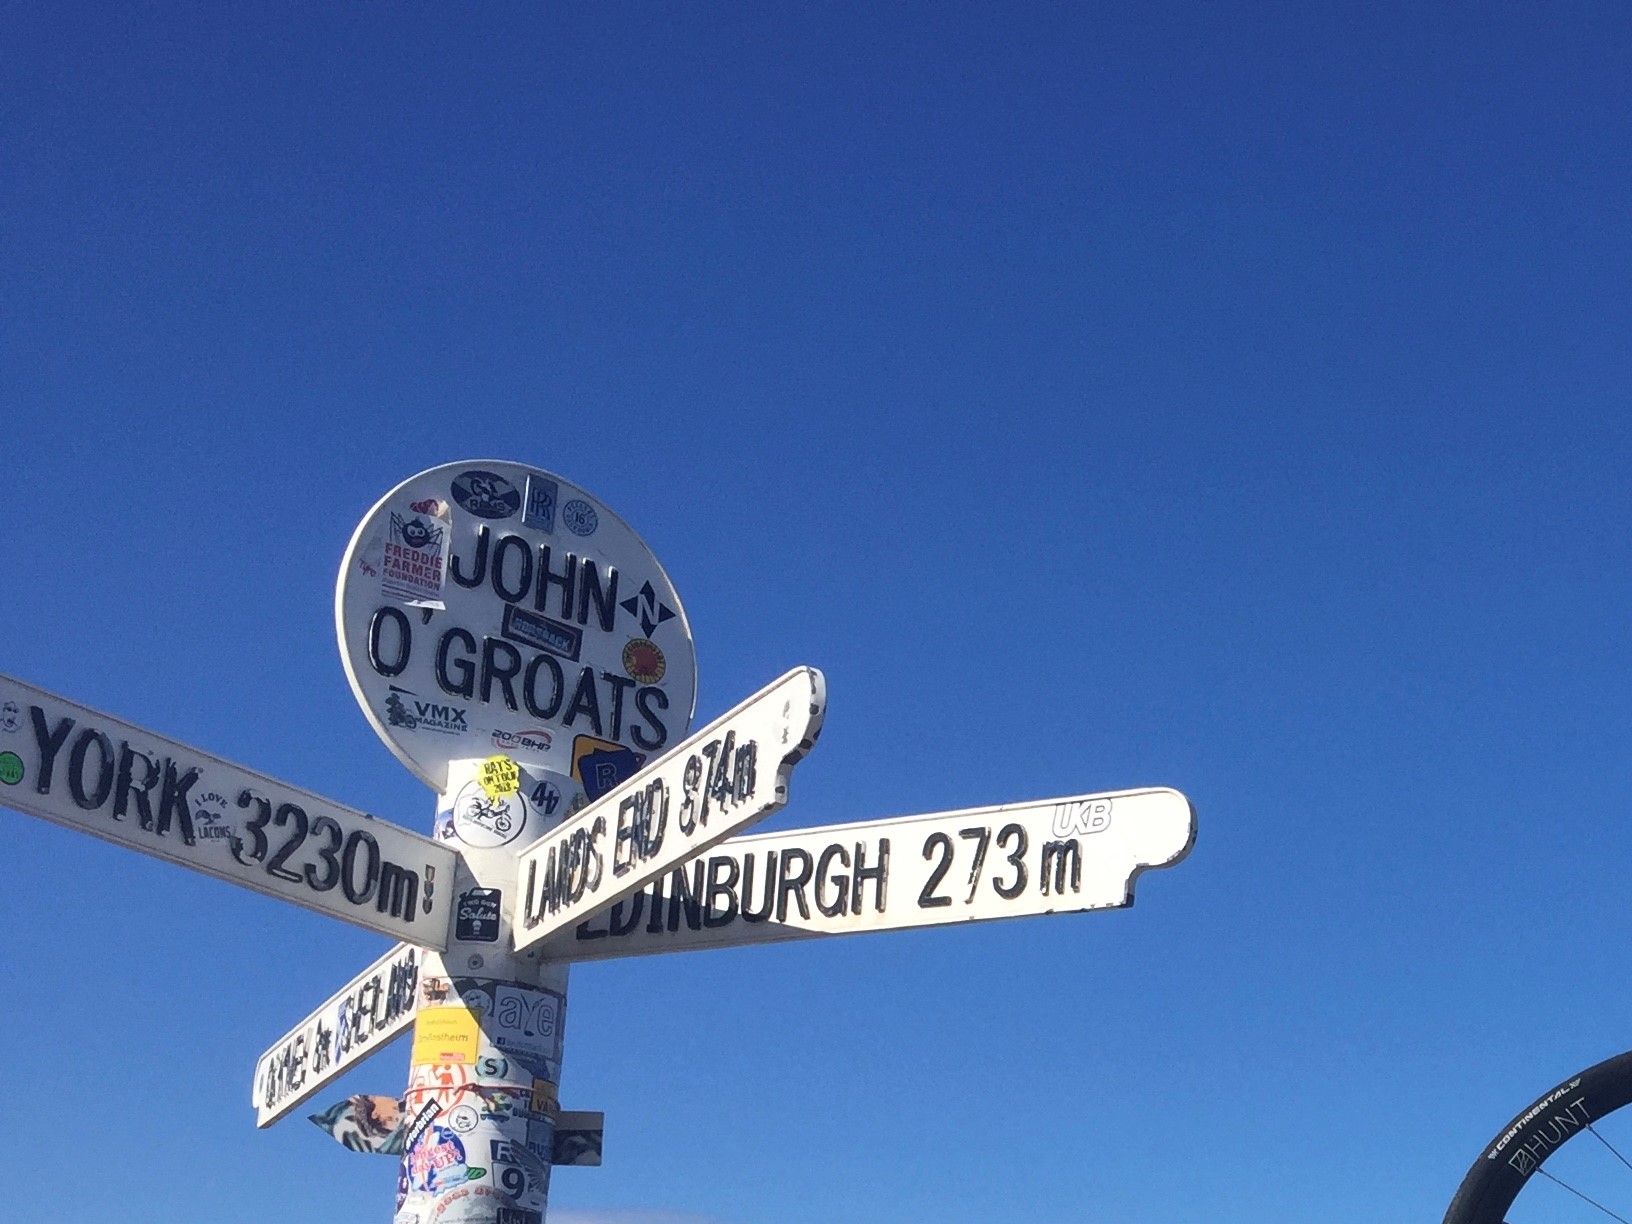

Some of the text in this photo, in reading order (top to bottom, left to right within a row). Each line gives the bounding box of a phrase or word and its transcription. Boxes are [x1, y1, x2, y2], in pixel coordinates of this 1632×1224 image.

[384, 541, 443, 570] FREDDIE
[384, 555, 442, 581] FARMER
[383, 568, 441, 592] FOUNDATION
[451, 524, 618, 632] JOHN
[414, 701, 467, 724] VMX
[415, 716, 469, 733] MAGAZINE
[29, 704, 200, 847] YORK
[1050, 797, 1114, 838] UKB
[459, 907, 498, 921] Salute
[1496, 1087, 1571, 1152] CONTINENTAL
[1524, 1096, 1591, 1160] HUNT
